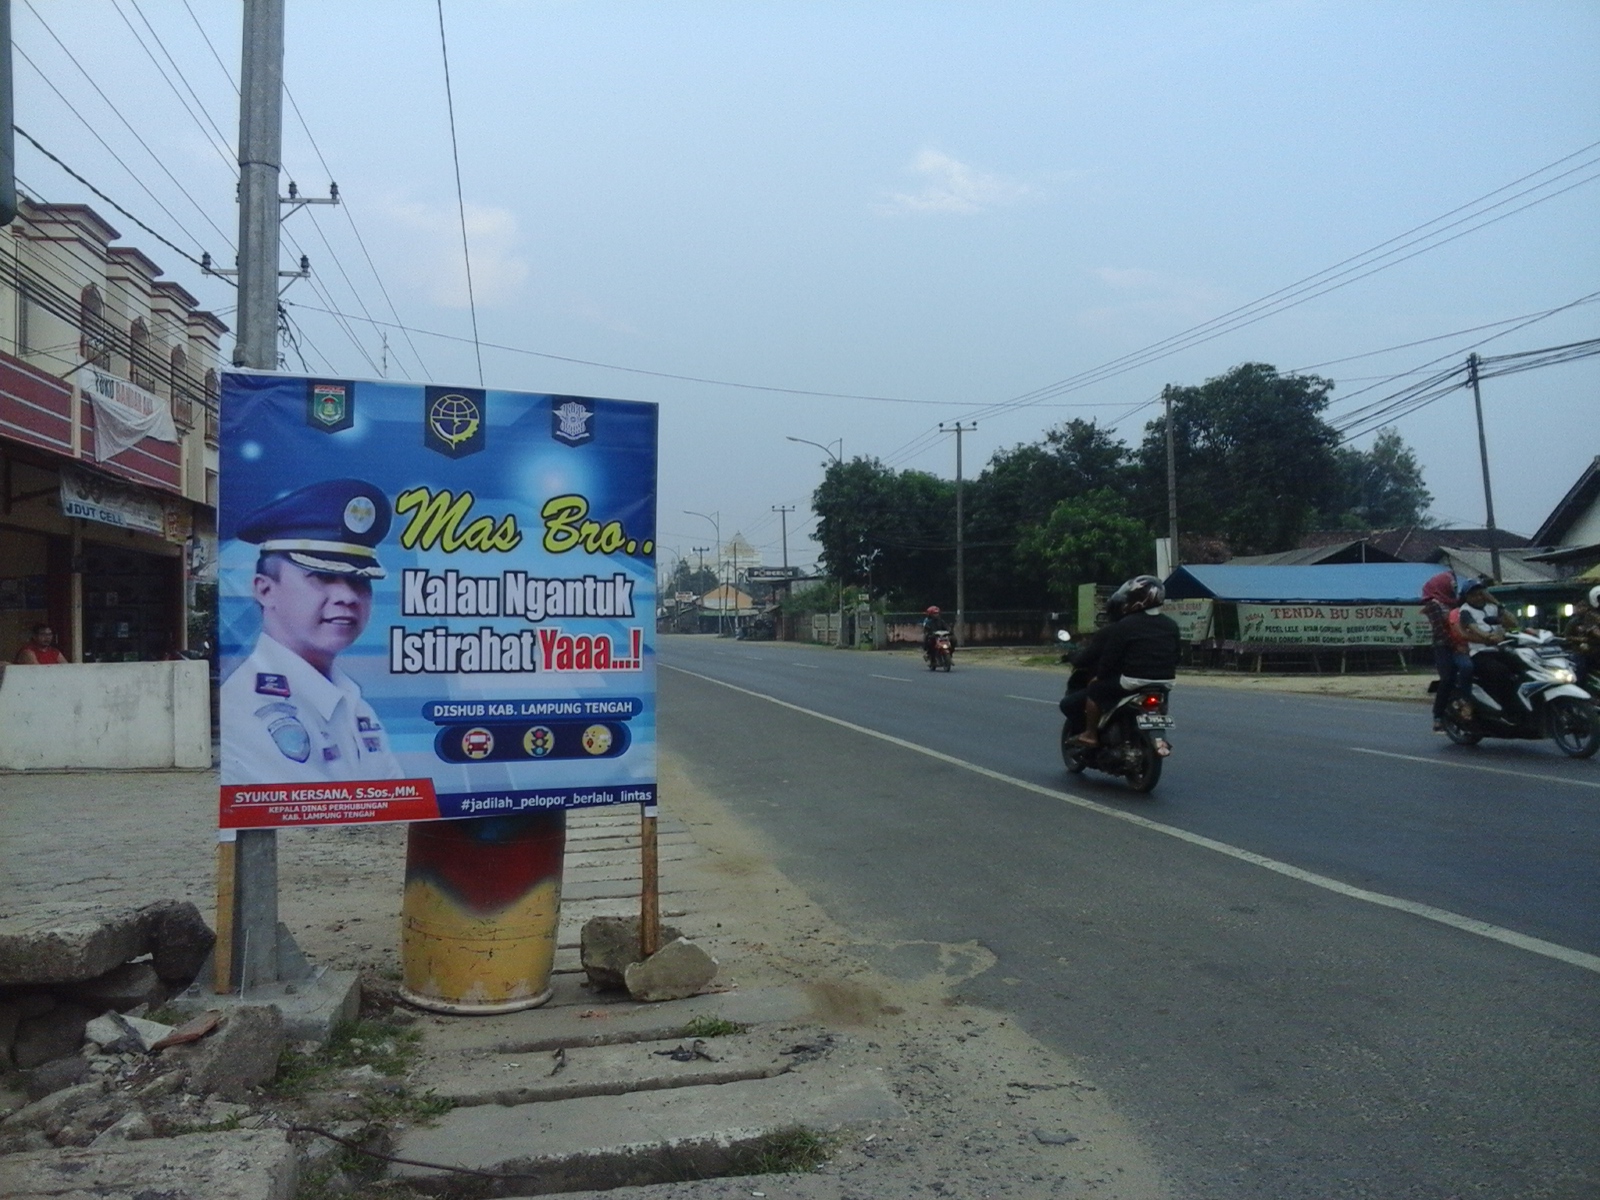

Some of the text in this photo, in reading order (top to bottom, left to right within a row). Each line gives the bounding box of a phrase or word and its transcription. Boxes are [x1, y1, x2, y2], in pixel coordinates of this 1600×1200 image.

[100, 510, 124, 524] CELL
[397, 487, 522, 553] Mas
[402, 569, 635, 621] Kalau Ngantuk
[1271, 606, 1404, 619] TENDA BU SUSAN
[1265, 625, 1283, 633] PECEL
[1284, 625, 1299, 633] LELE
[390, 626, 644, 673] Istirahat Yaaa...!
[433, 701, 633, 717] DISHUB KAB. LAMPUNG TENGAH
[235, 789, 288, 804] SYUKUR
[291, 788, 353, 801] KERSANA,
[461, 790, 653, 812] #jadilah_pelopor_berlalu_lintas
[268, 802, 389, 814] KEPALA DINAS PERHUBUNGAN
[282, 810, 376, 821] KAB. LAMPUNG TENGAH
